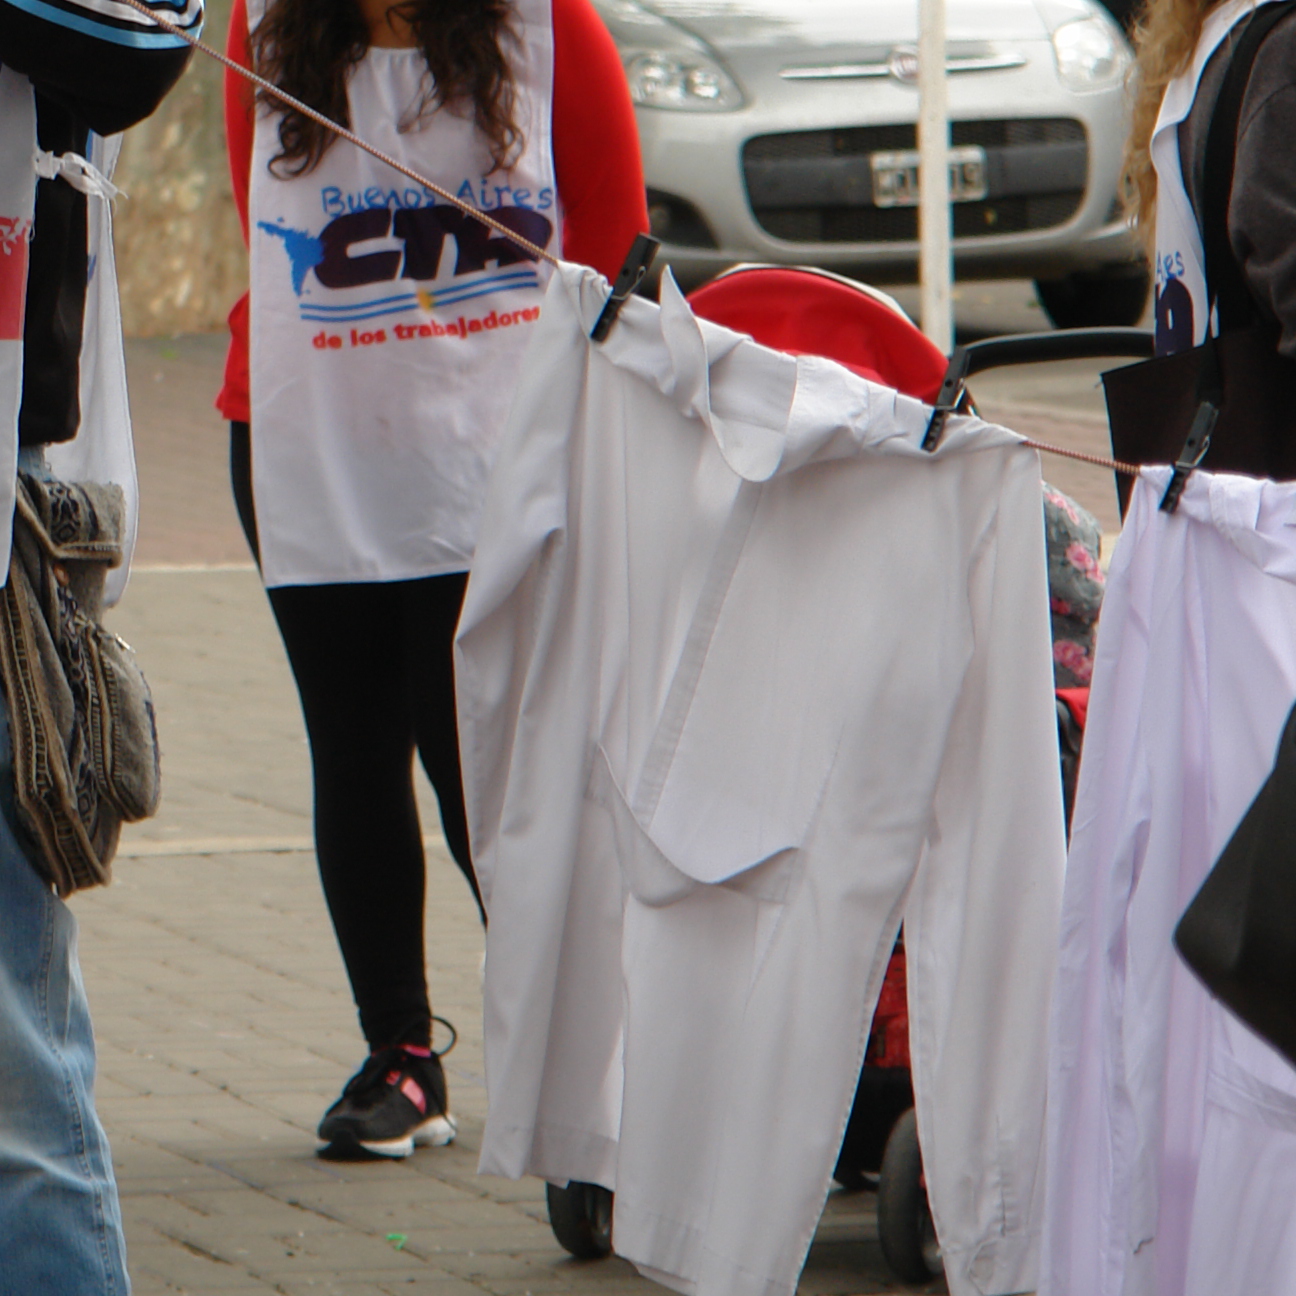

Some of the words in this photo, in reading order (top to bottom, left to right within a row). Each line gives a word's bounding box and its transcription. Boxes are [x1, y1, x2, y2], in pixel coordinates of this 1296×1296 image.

[320, 186, 436, 218] Buenos
[457, 179, 553, 210] Aires
[314, 205, 553, 289] CTA
[312, 330, 342, 350] de
[350, 329, 386, 347] los
